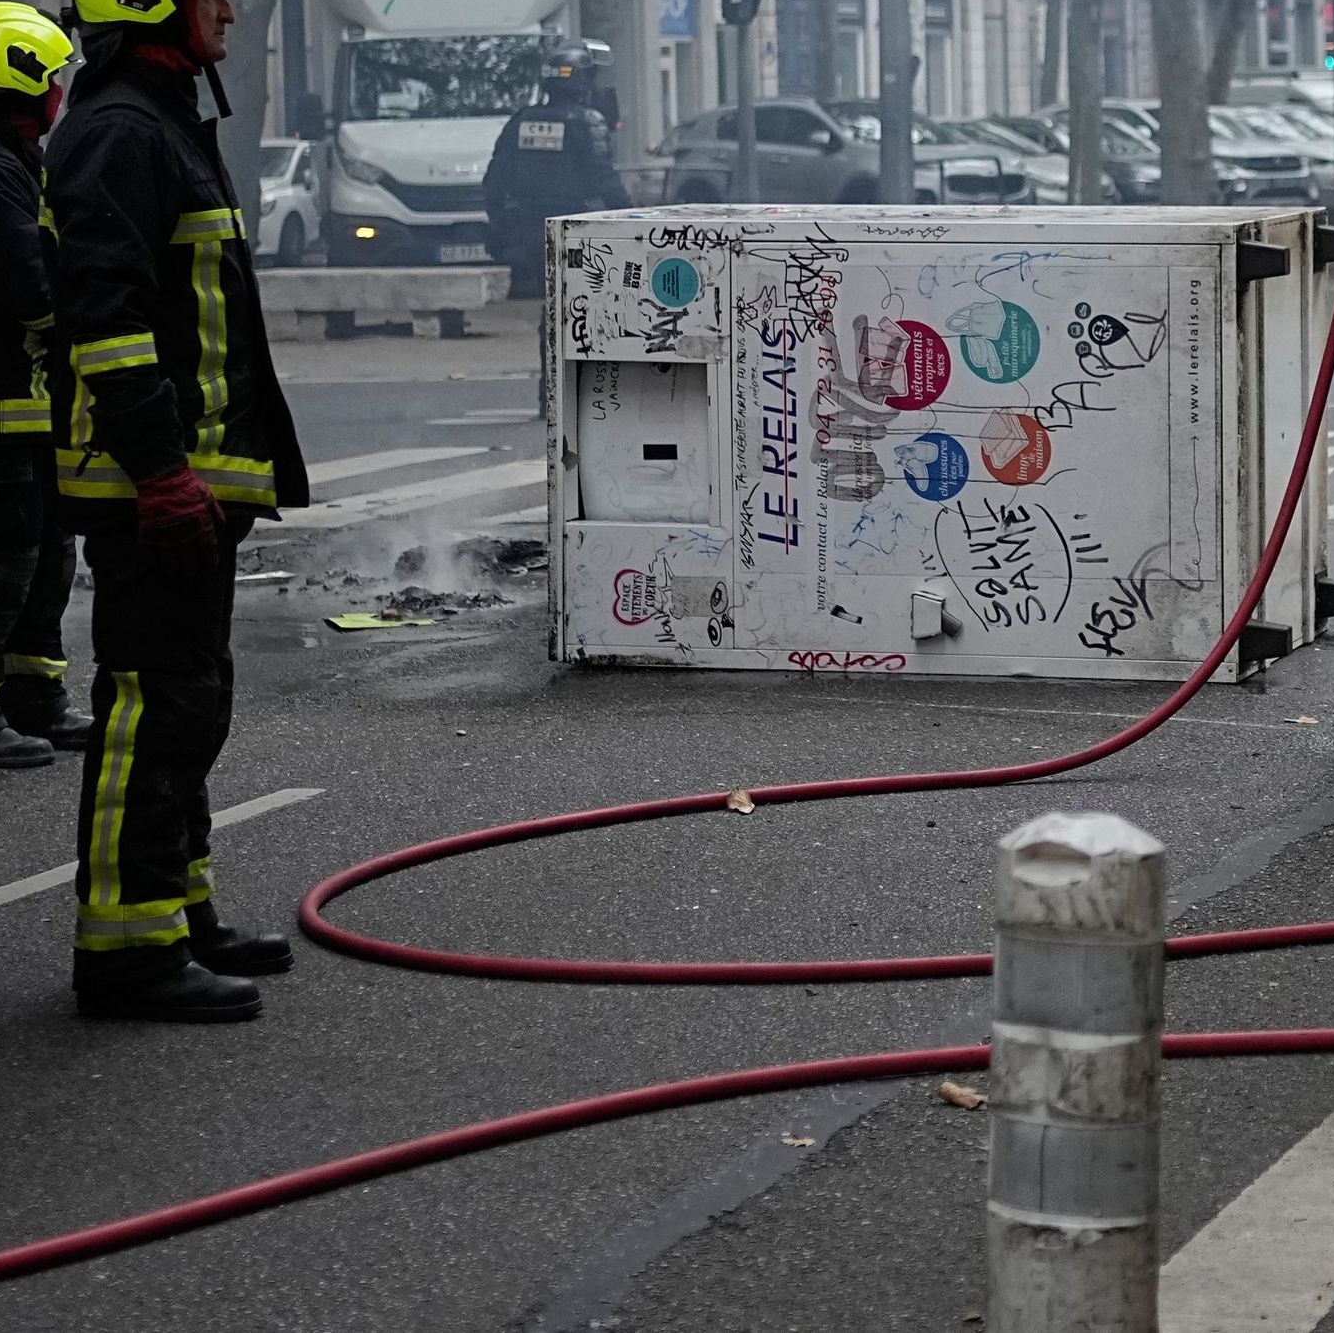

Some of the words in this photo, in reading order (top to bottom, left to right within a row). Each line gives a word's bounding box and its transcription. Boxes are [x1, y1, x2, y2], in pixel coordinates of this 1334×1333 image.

[631, 263, 642, 289] BDK
[926, 338, 933, 346] et
[1001, 341, 1010, 366] petite
[1009, 310, 1019, 378] maroquinerie
[1187, 279, 1202, 424] www.lerelais.org
[817, 346, 836, 372] 31
[911, 331, 923, 401] vêtements
[926, 348, 936, 392] propres
[937, 353, 945, 377] secs
[762, 327, 798, 479] RELAIS
[817, 378, 835, 406] 72
[816, 413, 835, 445] 04
[850, 433, 863, 450] ici
[1027, 452, 1035, 463] de
[1034, 430, 1043, 469] maison
[816, 458, 829, 499] Relais
[1017, 453, 1028, 481] linge
[758, 492, 799, 547] LE
[816, 503, 828, 519] Le
[817, 523, 827, 573] contact
[621, 583, 631, 612] ESPACE
[631, 574, 643, 622] VETEMENTS
[644, 575, 656, 608] COEUR
[816, 576, 826, 611] votre
